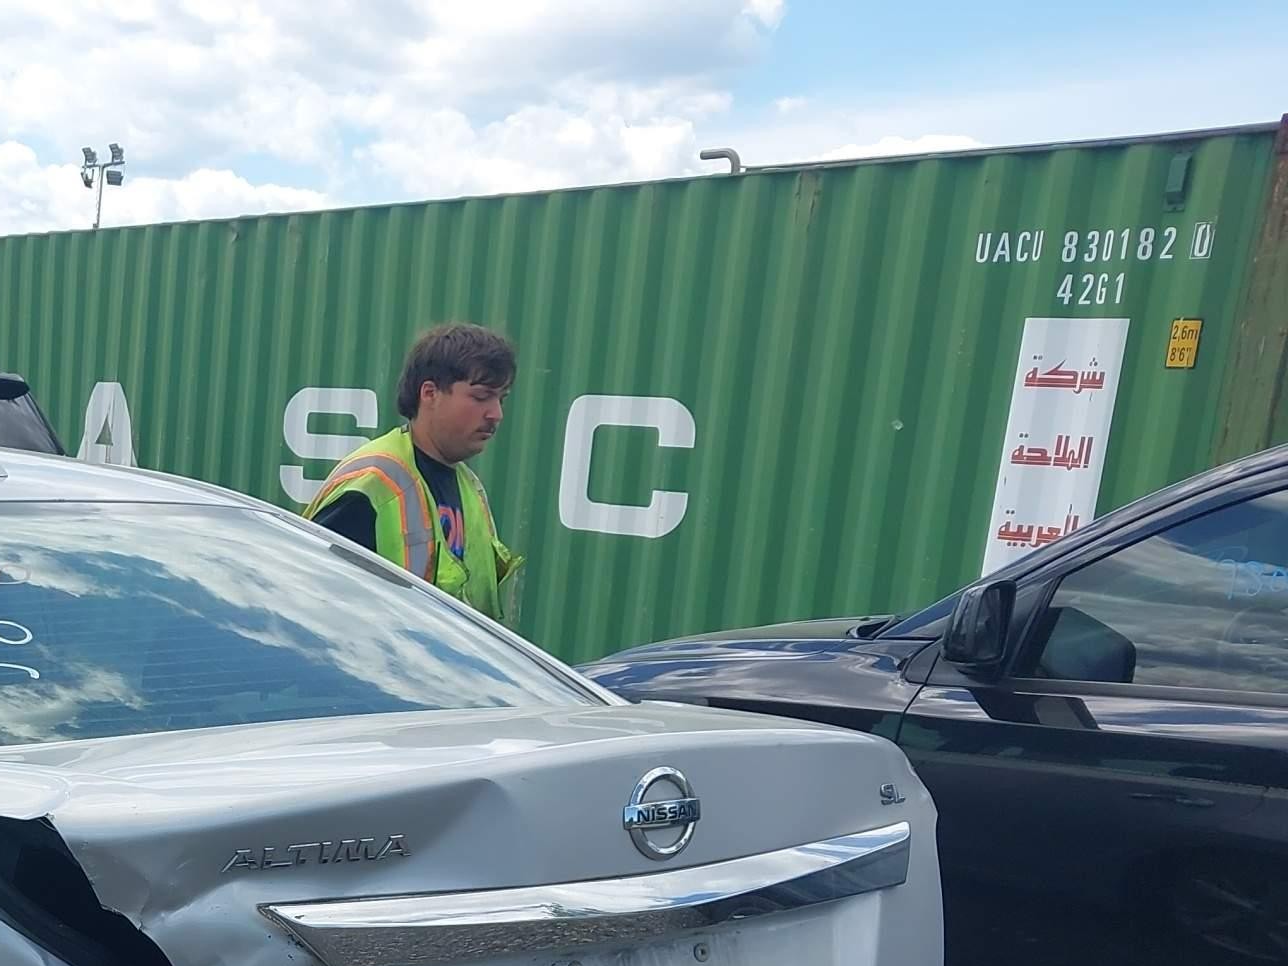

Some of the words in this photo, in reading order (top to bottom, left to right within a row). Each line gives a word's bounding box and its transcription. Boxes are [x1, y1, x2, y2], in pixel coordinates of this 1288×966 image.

[976, 230, 1044, 263] UACU
[1062, 227, 1177, 263] 830182
[1056, 273, 1125, 305] 42G1
[1024, 355, 1105, 394] شركة
[637, 804, 696, 823] NISSAN
[222, 834, 411, 873] ALTIMA
